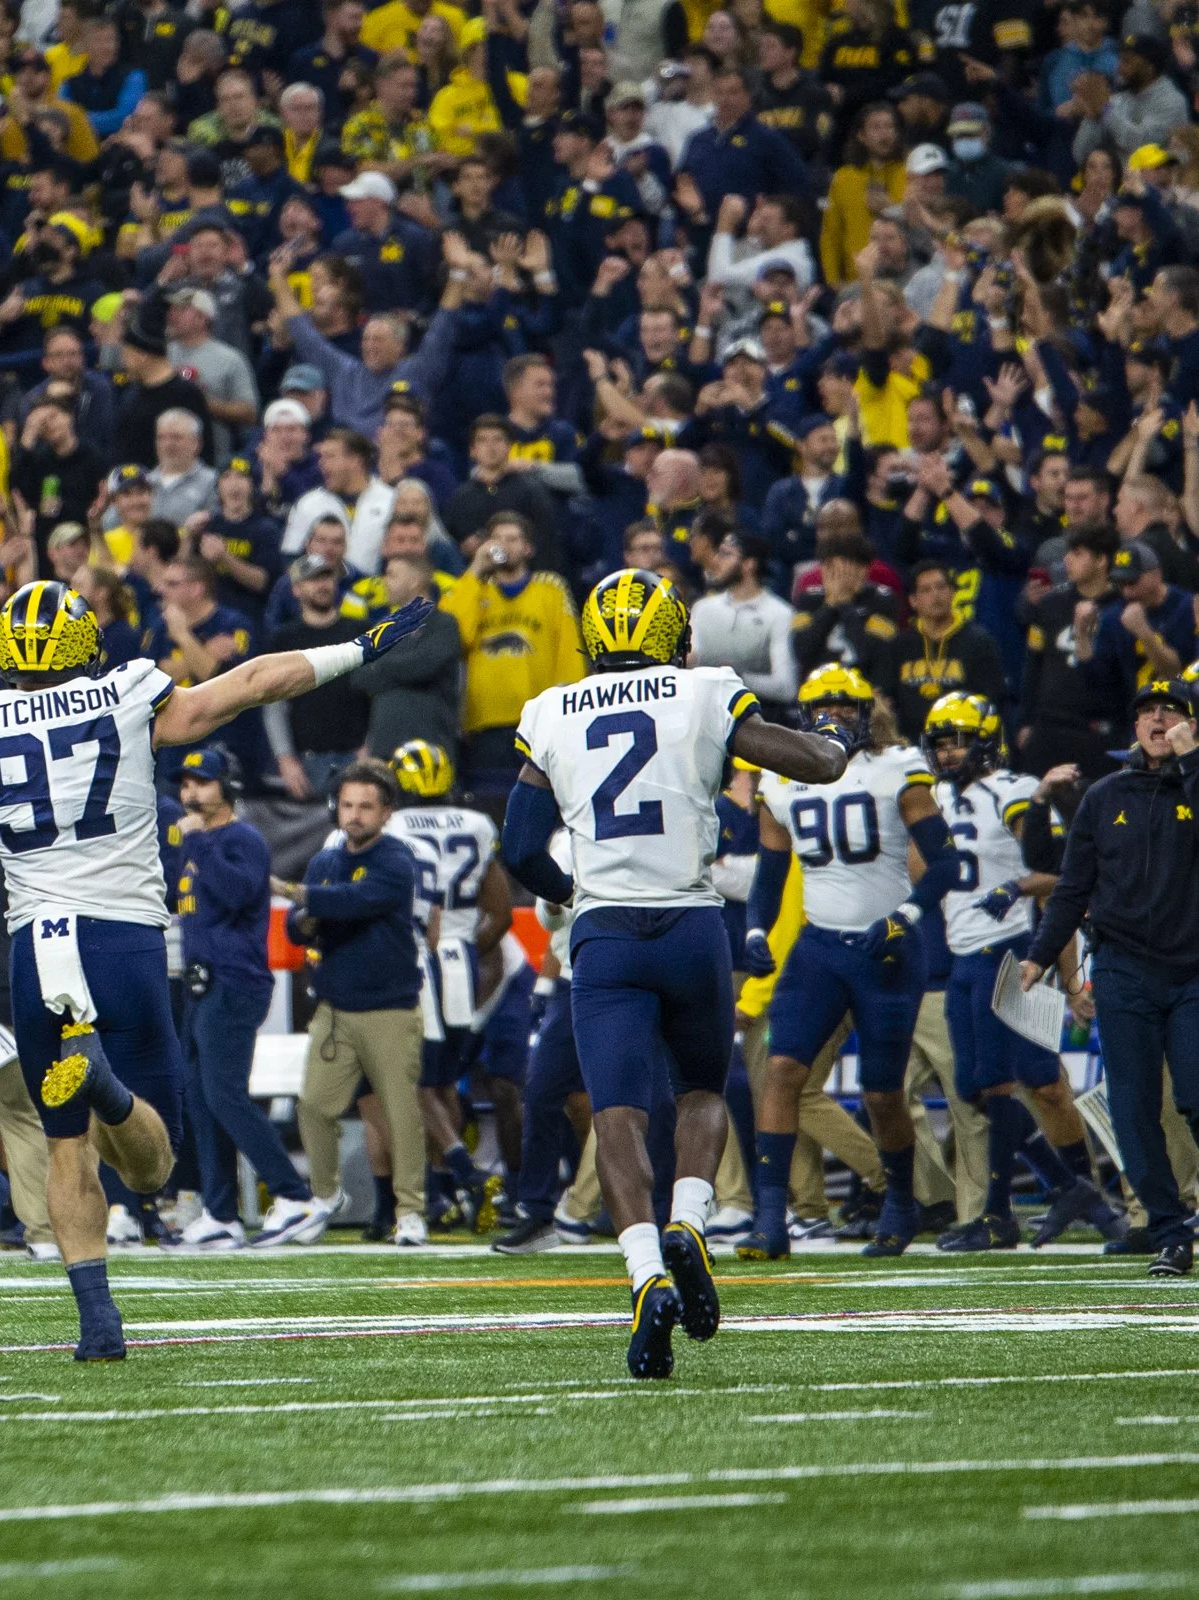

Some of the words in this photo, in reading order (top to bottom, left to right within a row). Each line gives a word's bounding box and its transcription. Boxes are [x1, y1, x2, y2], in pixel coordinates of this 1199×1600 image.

[563, 675, 677, 715] HAWKINS
[586, 710, 665, 842] 2
[789, 791, 881, 868] 90
[41, 917, 70, 939] M
